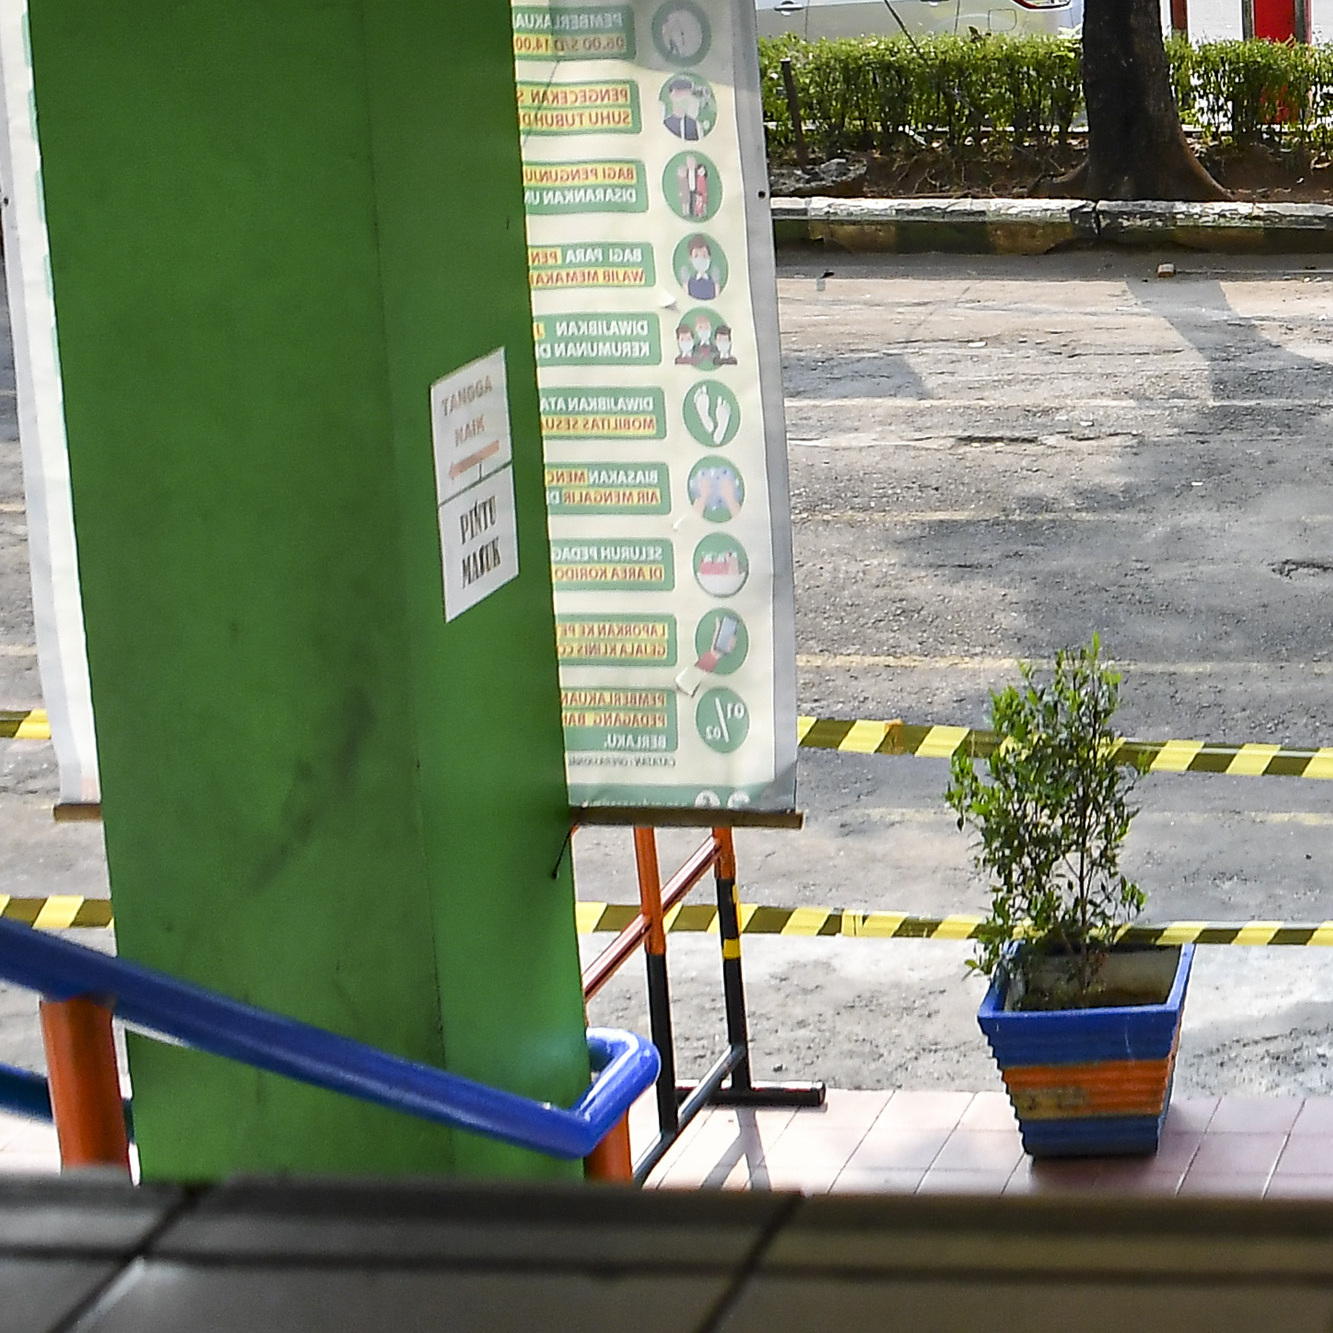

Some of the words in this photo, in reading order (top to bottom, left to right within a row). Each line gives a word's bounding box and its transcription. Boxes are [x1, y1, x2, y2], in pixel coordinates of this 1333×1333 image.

[454, 415, 486, 447] NAIK
[460, 495, 497, 545] PINTU
[461, 537, 502, 589] MASUK
